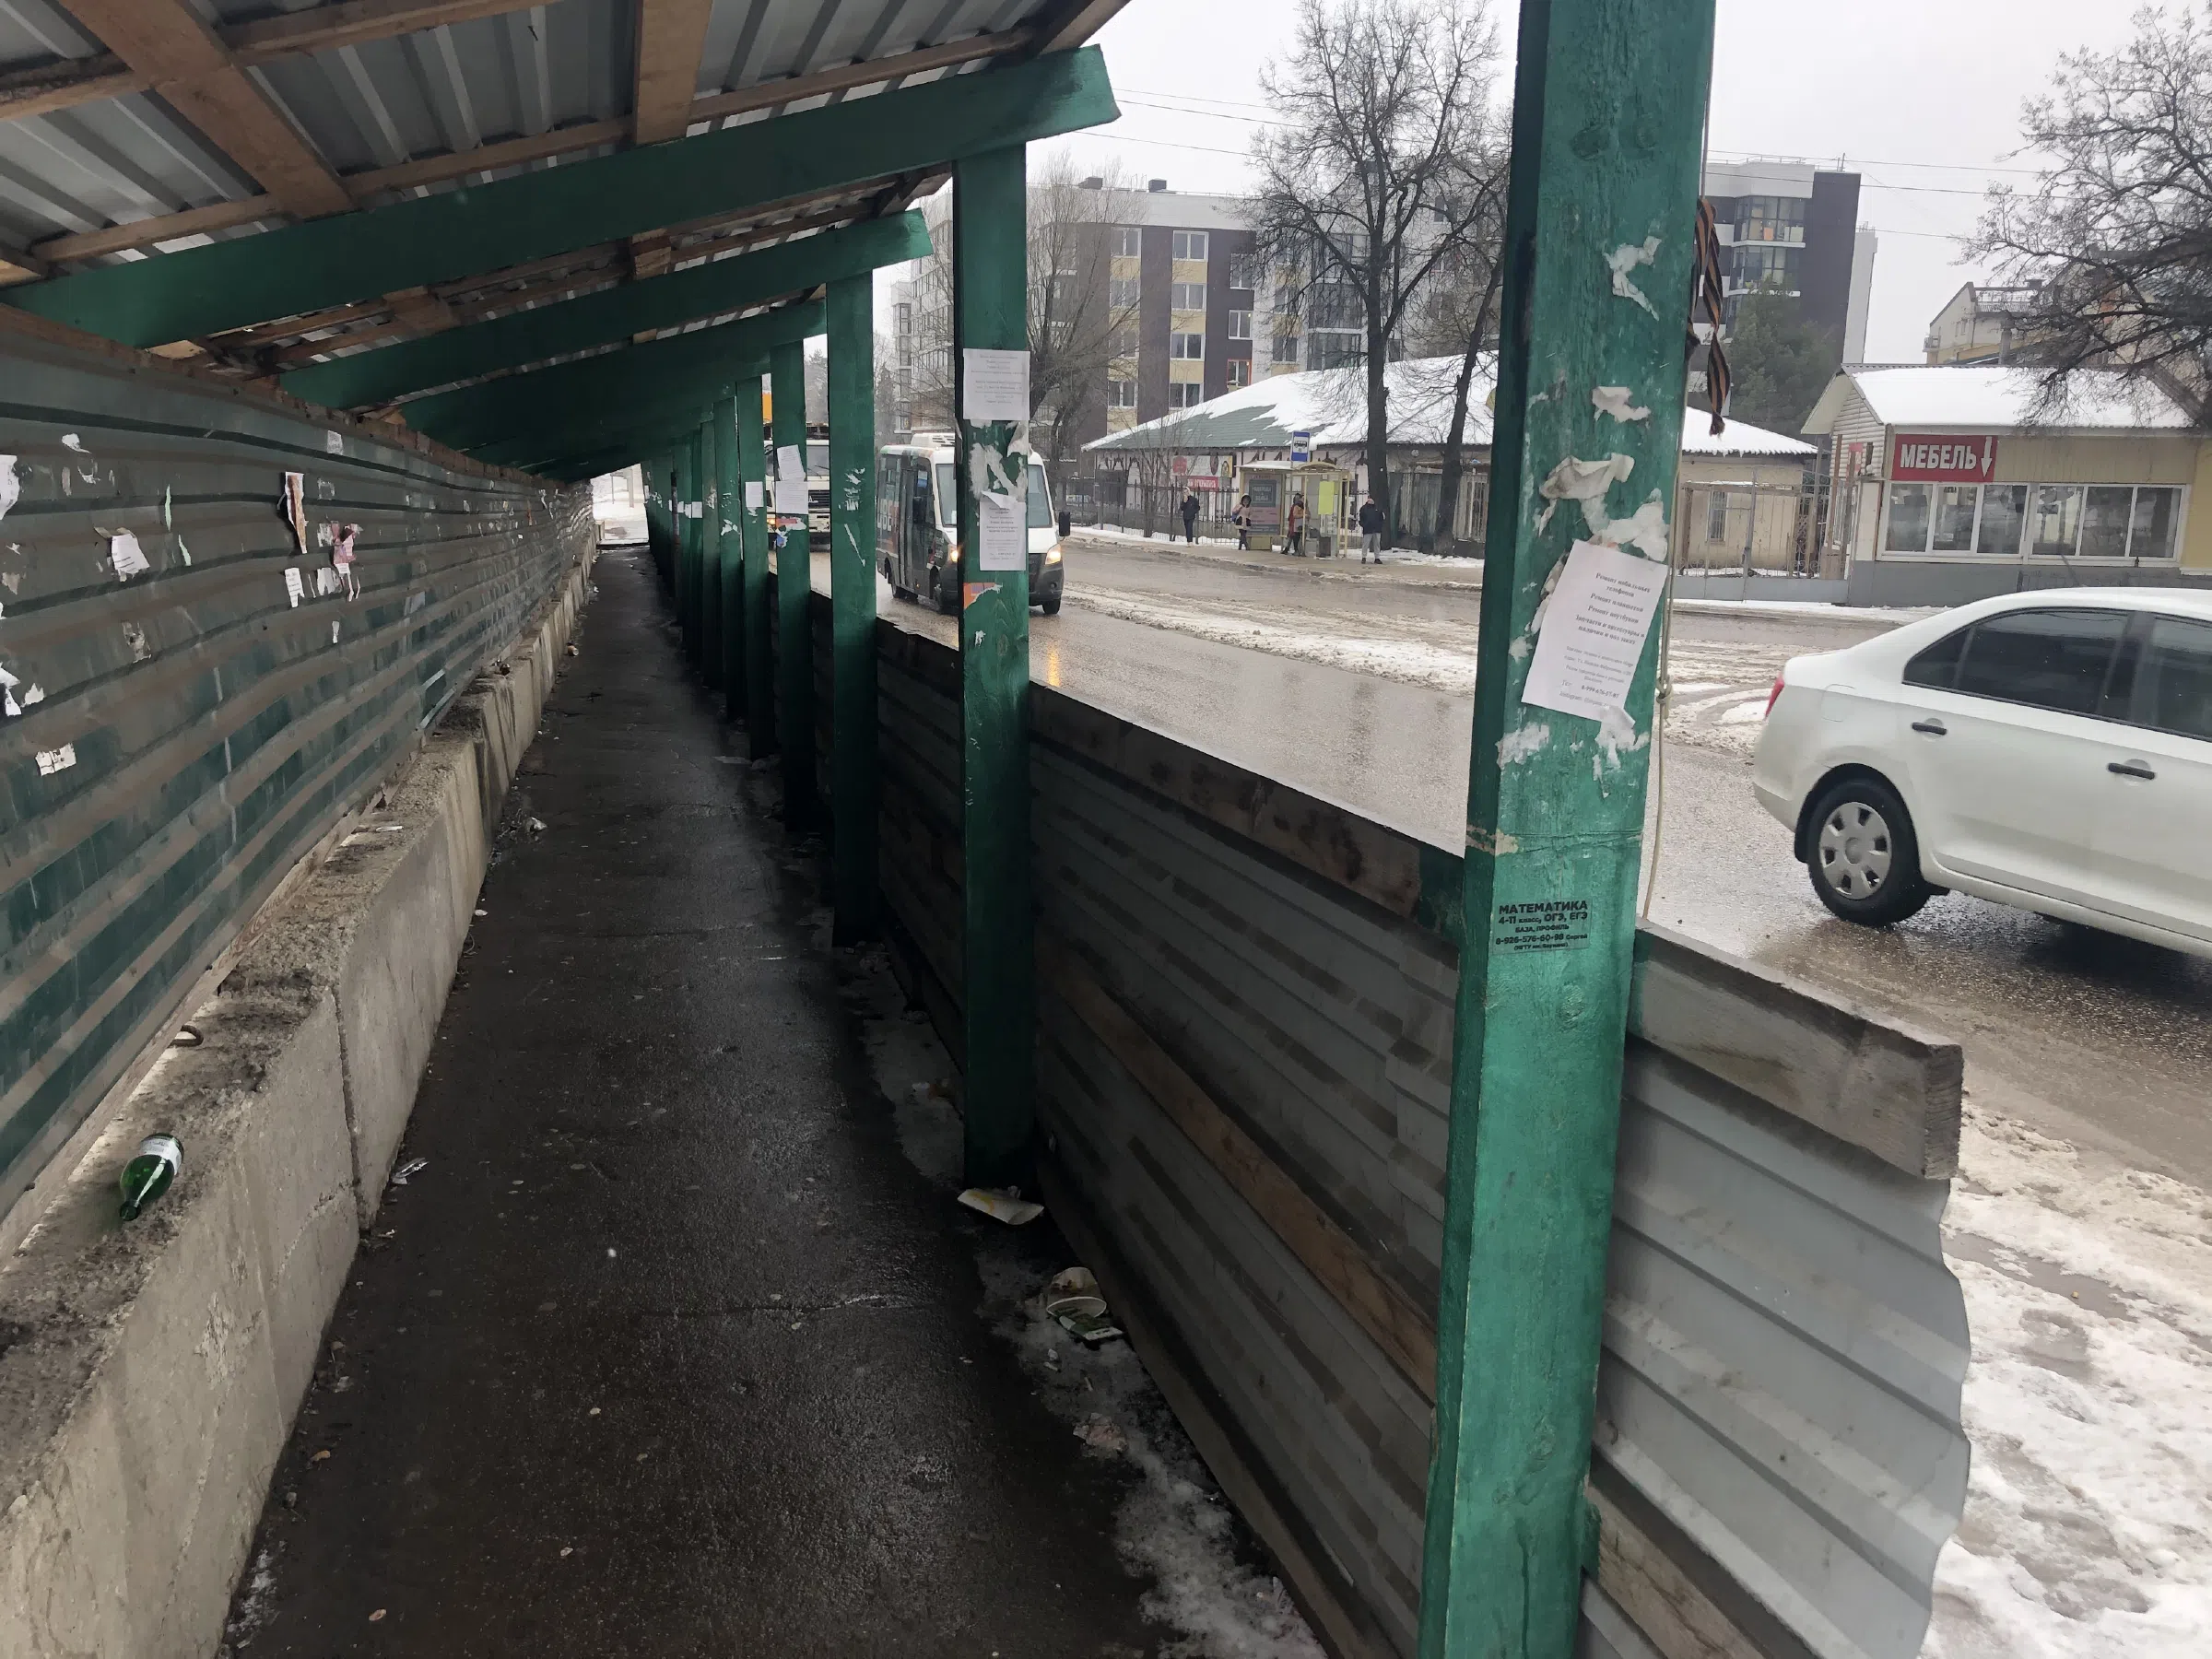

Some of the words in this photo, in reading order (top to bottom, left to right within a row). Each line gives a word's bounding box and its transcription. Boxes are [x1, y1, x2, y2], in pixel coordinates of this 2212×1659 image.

[1900, 443, 1977, 470] МЕБЕЛЬ
[1595, 572, 1617, 583] Ремонт
[1590, 593, 1611, 604] Ремонт
[1587, 605, 1609, 616] Ремонт
[1575, 614, 1602, 627] Запчасти
[1499, 900, 1588, 914] МАТЕМАТИКА
[1498, 915, 1516, 924] 4-11
[1544, 912, 1567, 923] ОГЭ,
[1569, 912, 1588, 921] ЕГЭ
